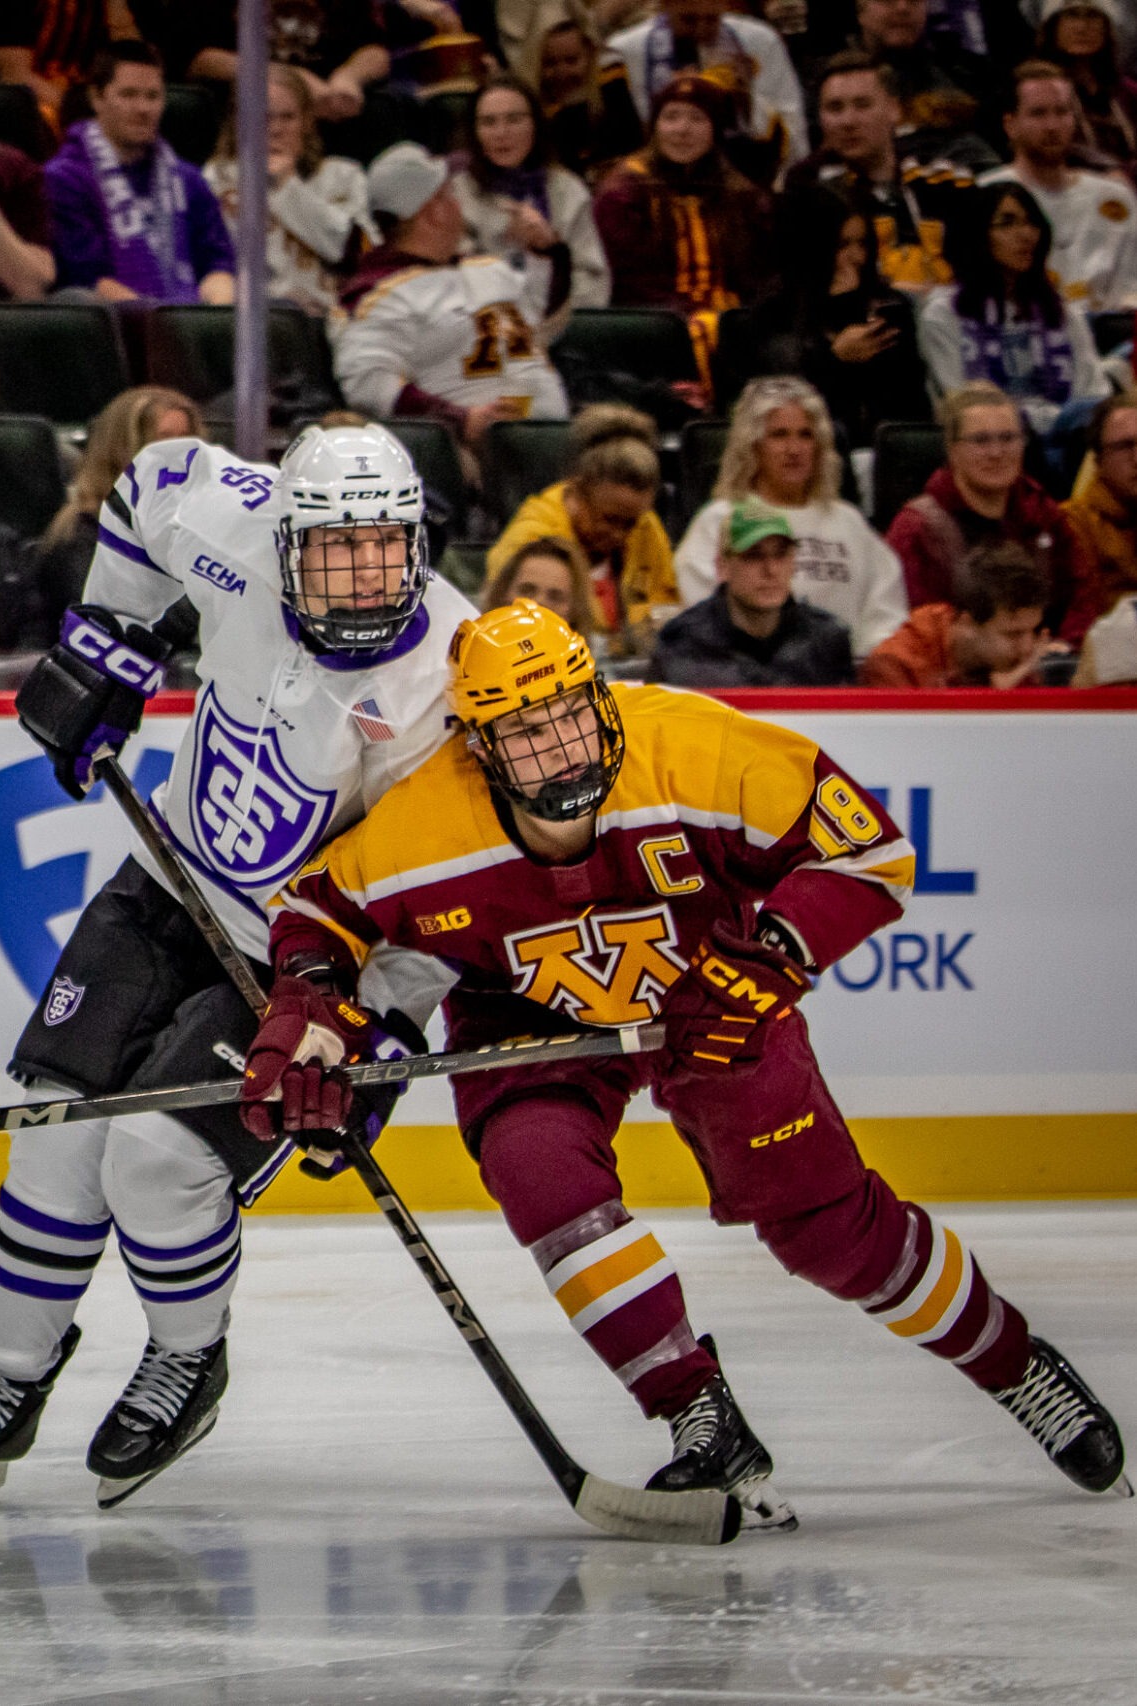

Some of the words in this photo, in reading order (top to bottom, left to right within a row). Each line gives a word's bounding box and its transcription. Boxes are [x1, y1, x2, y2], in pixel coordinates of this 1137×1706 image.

[340, 490, 390, 501] CCM
[192, 554, 247, 597] CCHA
[341, 628, 388, 641] CCM
[516, 664, 556, 689] GOPHERS
[807, 772, 884, 862] 18
[637, 832, 705, 896] C
[692, 942, 778, 1014] CM
[811, 931, 977, 993] ORK
[750, 1111, 814, 1149] CCM
